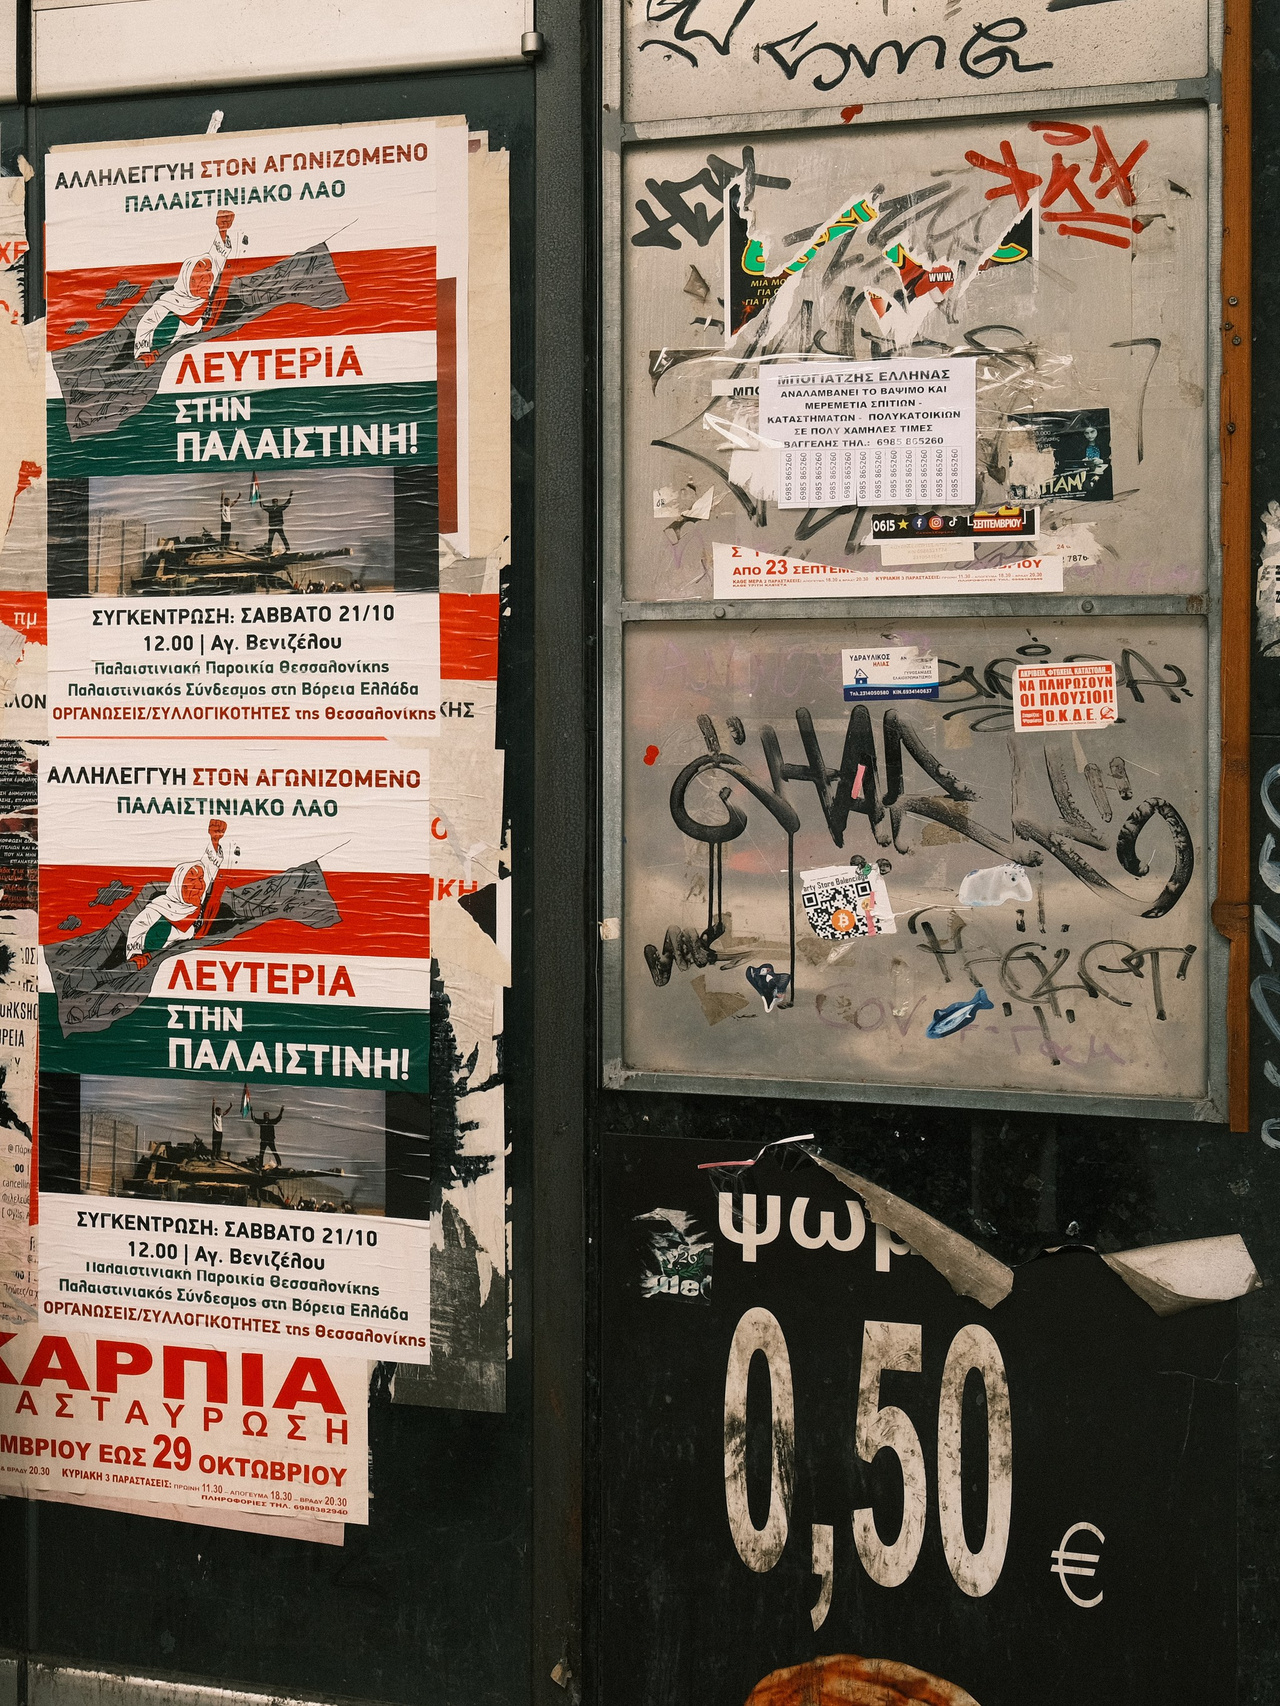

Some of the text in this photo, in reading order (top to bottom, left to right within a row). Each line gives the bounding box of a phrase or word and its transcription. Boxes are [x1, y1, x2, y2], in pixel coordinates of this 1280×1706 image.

[54, 142, 429, 190] ΑΛΛΗΛΕΓΓΥΗ ΣΤΟΝ ΑΓΩΝΙΖΟΜΕΝΟ
[125, 179, 346, 214] ΠΑΛΑΙΣΤΙΝΙΑΚΟ ΛΑΟ
[175, 345, 364, 385] ΛΕΥΤΕΡΙΑ
[879, 369, 950, 381] ΕΛΛΗΝΑΣ
[780, 389, 859, 398] ΑΝΑΛΑΜΒΑΝΕΙ
[862, 388, 877, 396] ΤΟ
[880, 386, 925, 395] ΒΑΨΙΜΟ
[175, 396, 251, 425] ΣΤΗΝ
[805, 400, 916, 410] ΜΕΡΕΜΕΤΙΑ ΣΠΙΤΙΩΝ
[767, 411, 961, 424] ΚΑΤΑΣΤΗΜΑΤΩΝ ΠΟΛΥΚΑΤΟΙΚΙΩΝ
[811, 427, 840, 435] ΠΟΛΥ
[843, 425, 896, 434] ΧΑΜΗΛΕΣ
[900, 424, 933, 432] ΤΙΜΕΣ
[176, 421, 418, 463] ΠΑΛΑΙΣΤΙΝΗ!
[784, 439, 838, 448] ΒΑΓΓΕΛΗΣ
[842, 439, 870, 447] ΤΗΛ.:
[877, 438, 903, 446] 6985
[873, 518, 895, 532] 0615
[973, 518, 1022, 529] ΣΕΠΤΕΜΒΡΙΟΥ
[733, 559, 788, 575] ΑΠΟ 23
[92, 604, 395, 627] ΣΥΓΚΕΝΤΡΩΣΗ: ΣΑΒΒΑΤΟ 21/10
[143, 633, 342, 655] 12.00 Αγ. Βενιζέλου
[94, 660, 390, 677] Παλαιστινιακή Παροικία Θεσσαλονίκης
[68, 681, 419, 700] Παλαιστινιακός Σύνδεσμος στη Βόρεια Ελλάδα
[1019, 676, 1112, 691] ΝΑ ΠΛΗΡΩΣΟΥΝ
[1020, 690, 1113, 707] ΟΙ ΠΛΟΥΣΙΟΙ!
[52, 705, 290, 722] ΟΡΓΑΝΩΣΕΙΣ/ΣΥΛΛΟΓΙΚΟΤΗΤΕΣ
[295, 708, 320, 721] της
[325, 706, 436, 722] Θεσσαλονίκης
[817, 880, 834, 889] Store
[168, 959, 356, 998] ΛΕΥΤΕΡΙΑ
[168, 1004, 243, 1032] ΣΤΗΝ
[168, 1037, 410, 1081] ΠΑΛΑΙΣΤΙΝΗ!
[99, 1444, 146, 1466] ΕΩΣ
[152, 1433, 192, 1471] 29
[198, 1454, 348, 1487] ΟΚΤΩΒΡΙΟΥ
[29, 1466, 50, 1476] 20.30
[62, 1468, 103, 1482] ΚΥΡΙΑΚΗ
[112, 1474, 171, 1489] ΠΑΡΑΣΤΑΣΕΙΣ:
[723, 1306, 1013, 1633] 0,50
[201, 1494, 267, 1507] ΠΛΗΡΟΦΟΡΙΕΣ
